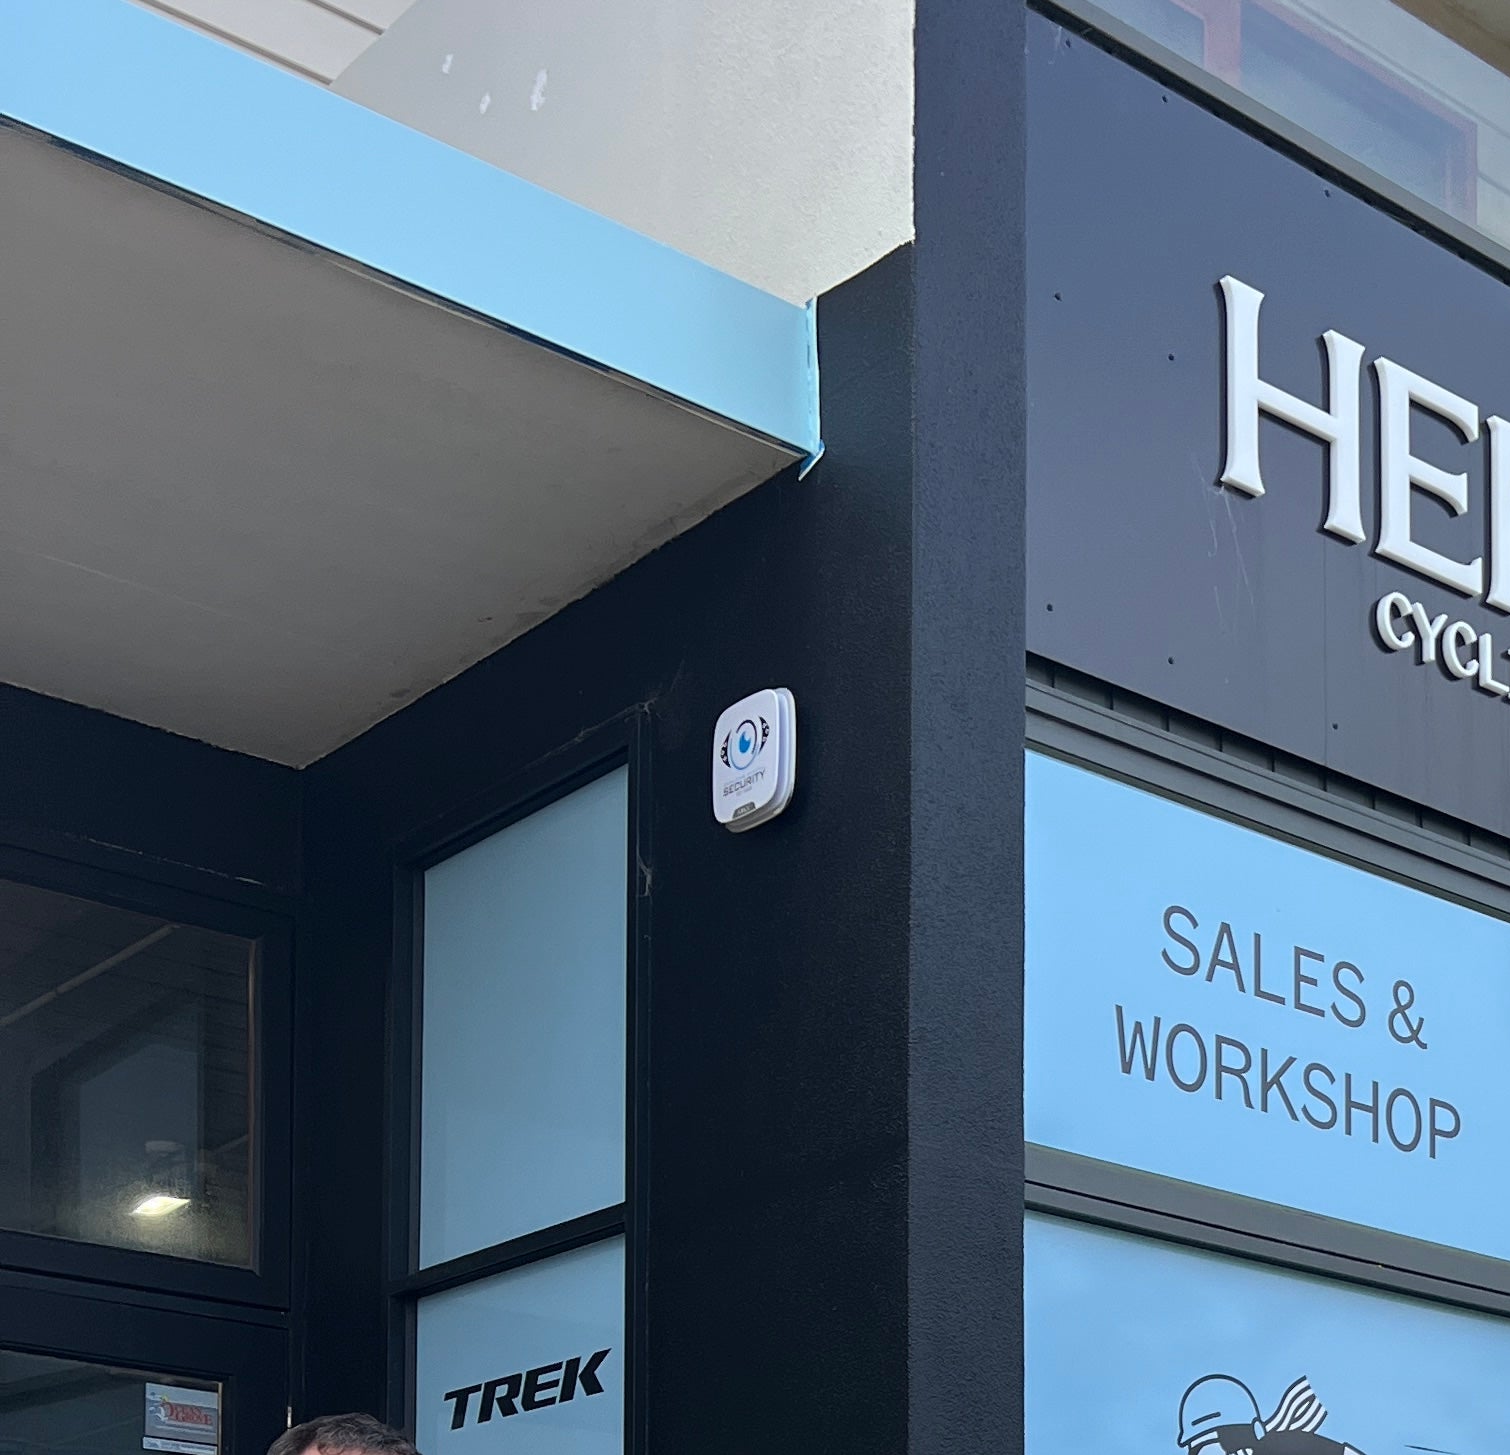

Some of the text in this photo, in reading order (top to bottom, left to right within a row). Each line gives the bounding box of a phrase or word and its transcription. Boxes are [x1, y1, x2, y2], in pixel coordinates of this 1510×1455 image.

[723, 769, 766, 796] SECURITY
[1161, 904, 1429, 1049] SALES &
[1115, 1003, 1461, 1160] WORKSHOP
[444, 1348, 612, 1430] TREK
